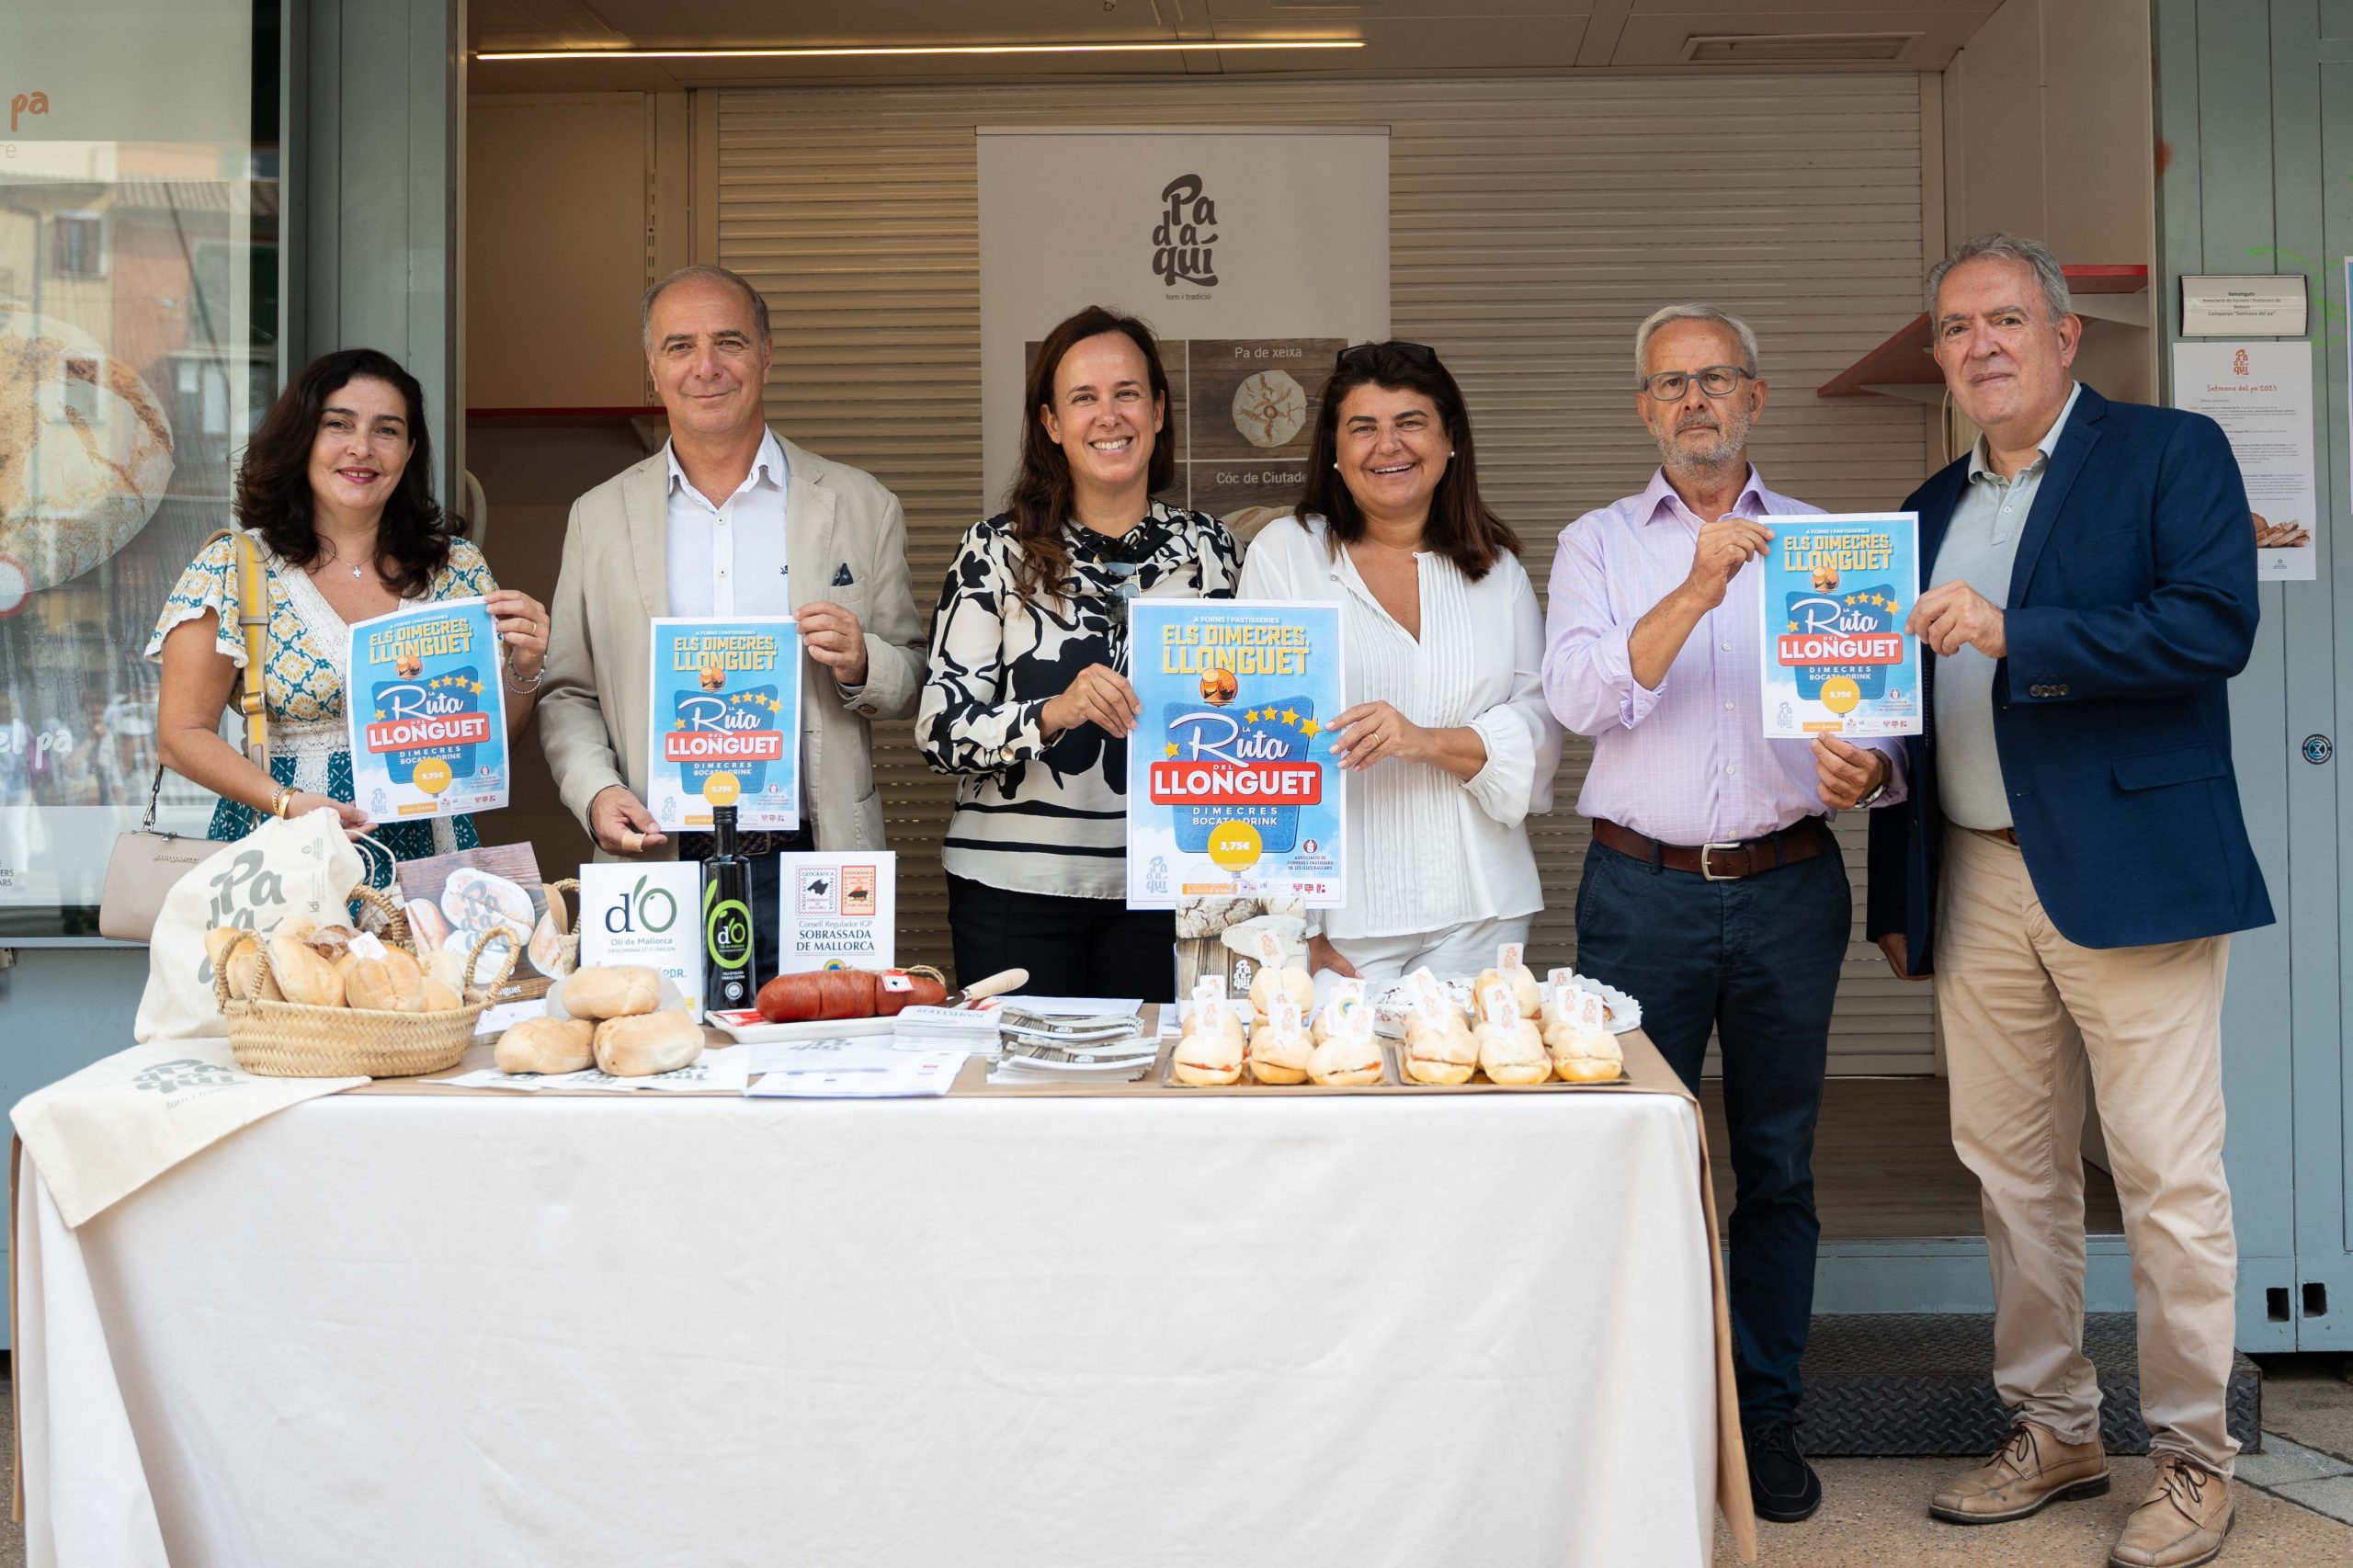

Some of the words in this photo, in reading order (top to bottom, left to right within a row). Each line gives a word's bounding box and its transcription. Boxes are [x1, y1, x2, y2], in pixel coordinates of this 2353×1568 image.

[11, 91, 49, 132] pa
[1162, 174, 1218, 226] Pa
[1235, 347, 1250, 358] Pa
[1254, 347, 1269, 358] de
[1272, 347, 1302, 358] xeixa
[1216, 472, 1239, 484] Cóc
[1244, 472, 1258, 483] de
[1262, 472, 1307, 483] Ciutade
[1784, 536, 1810, 551] ELS
[1785, 549, 1893, 571] LLONGUET
[1791, 598, 1878, 638] Ruta
[370, 630, 394, 646] ELS
[674, 637, 699, 651] ELS
[1163, 625, 1199, 645] ELS
[370, 632, 472, 664] LLONGUET
[1781, 639, 1898, 659] LLONGUET
[674, 651, 778, 671] LLONGUET
[1163, 646, 1309, 674] LLONGUET
[377, 685, 464, 721] Ruta
[678, 697, 761, 736] Ruta
[370, 718, 485, 747] LLONGUET
[1169, 712, 1290, 768] Ruta
[35, 729, 73, 769] pa
[400, 746, 461, 757] DIMECRES
[669, 737, 779, 755] LLONGUET
[1155, 770, 1316, 795] LLONGUET
[1193, 807, 1277, 815] DIMECRES
[1220, 841, 1251, 851] 3,75€
[210, 850, 287, 915] Pa
[799, 930, 871, 939] SOBRASSADA
[825, 920, 858, 929] Regulador
[796, 942, 811, 951] DE
[814, 942, 874, 951] MALLORCA
